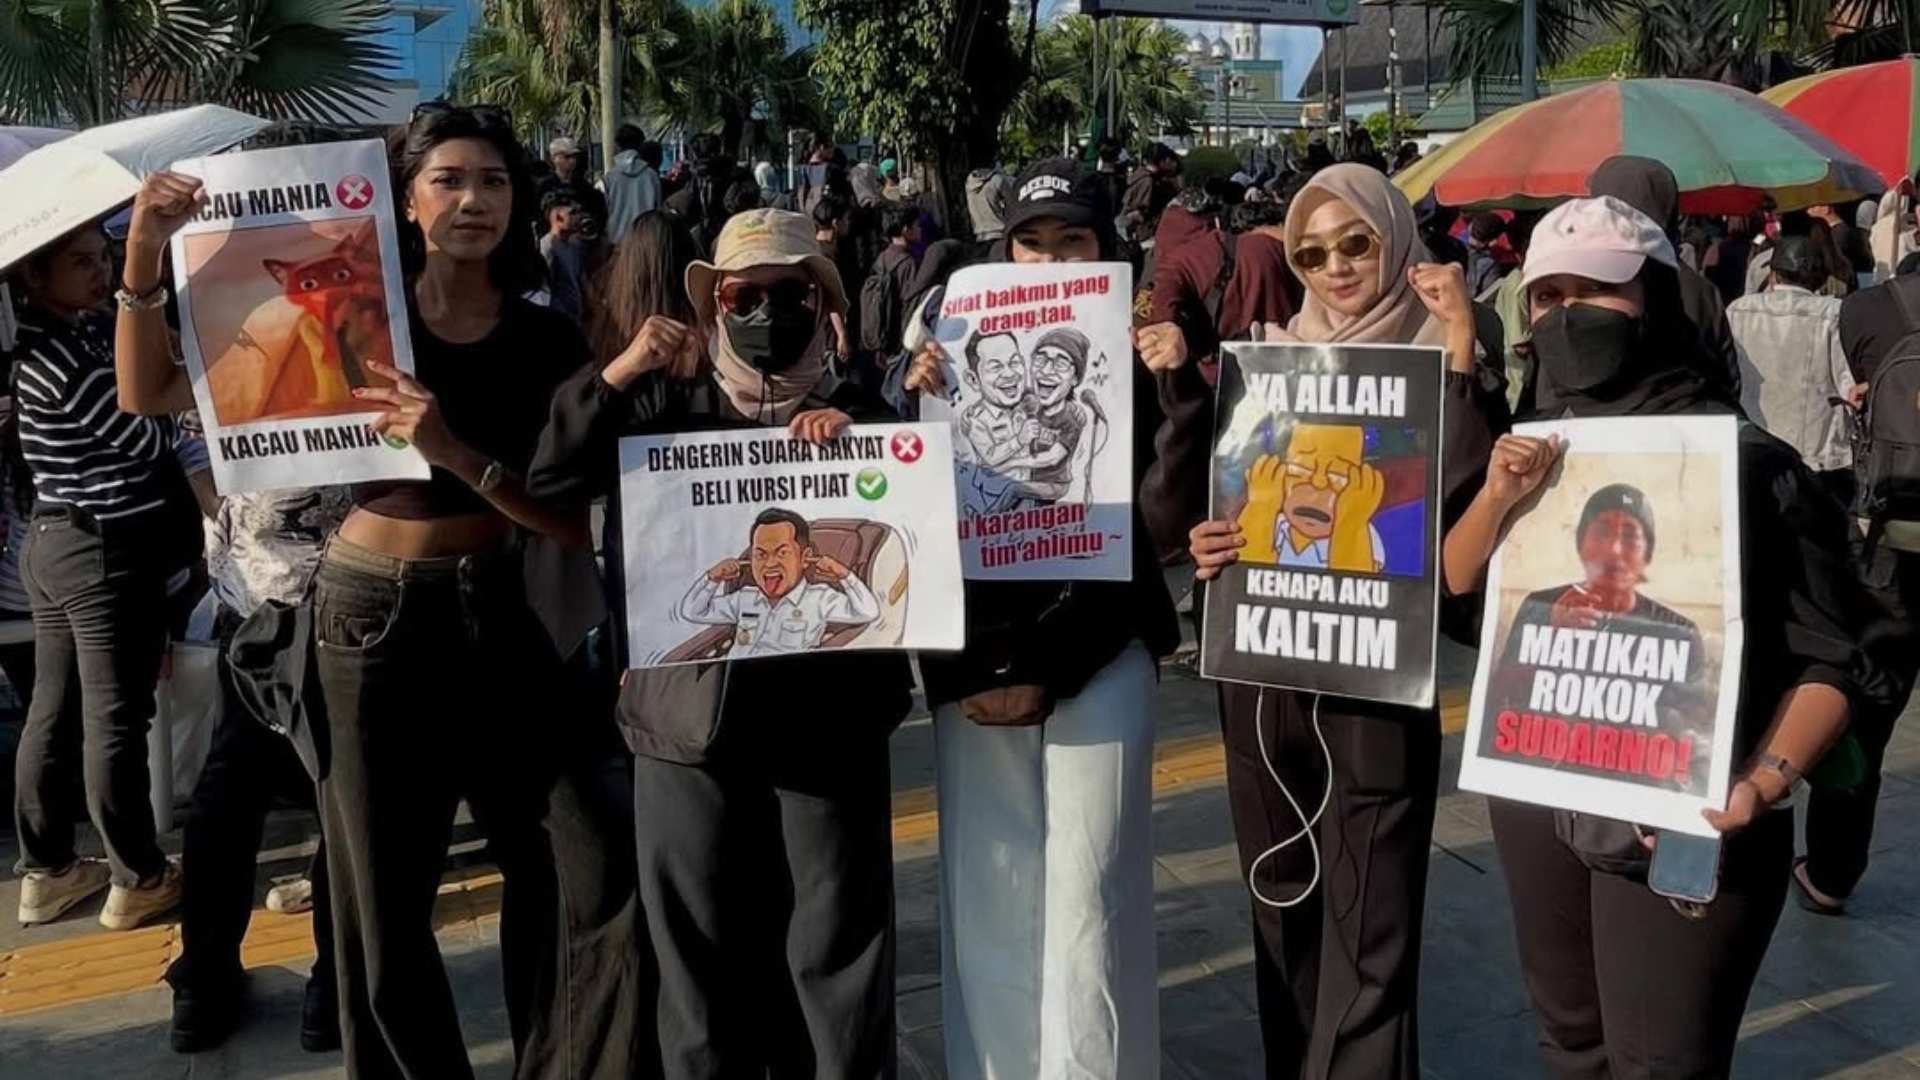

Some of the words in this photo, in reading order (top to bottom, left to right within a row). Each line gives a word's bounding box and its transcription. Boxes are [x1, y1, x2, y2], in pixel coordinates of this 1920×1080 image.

[249, 182, 333, 216] MANIA
[986, 283, 1057, 309] baikmu
[1062, 275, 1110, 299] yang
[1250, 373, 1289, 412] YA
[1294, 374, 1407, 417] ALLAH
[218, 430, 299, 461] KACAU
[303, 424, 380, 452] MANIA
[648, 443, 744, 472] DENGERIN
[748, 437, 813, 465] SUARA
[692, 480, 731, 507] BELI
[737, 475, 795, 502] KURSI
[800, 473, 850, 499] PIJAT
[1247, 568, 1335, 603] KENAPA
[1338, 577, 1390, 608] AKU
[1235, 603, 1397, 670] KALTIM
[1518, 624, 1691, 683] MATIKAN
[1529, 670, 1664, 727] ROKOK
[1495, 710, 1693, 784] SUDARNO!
